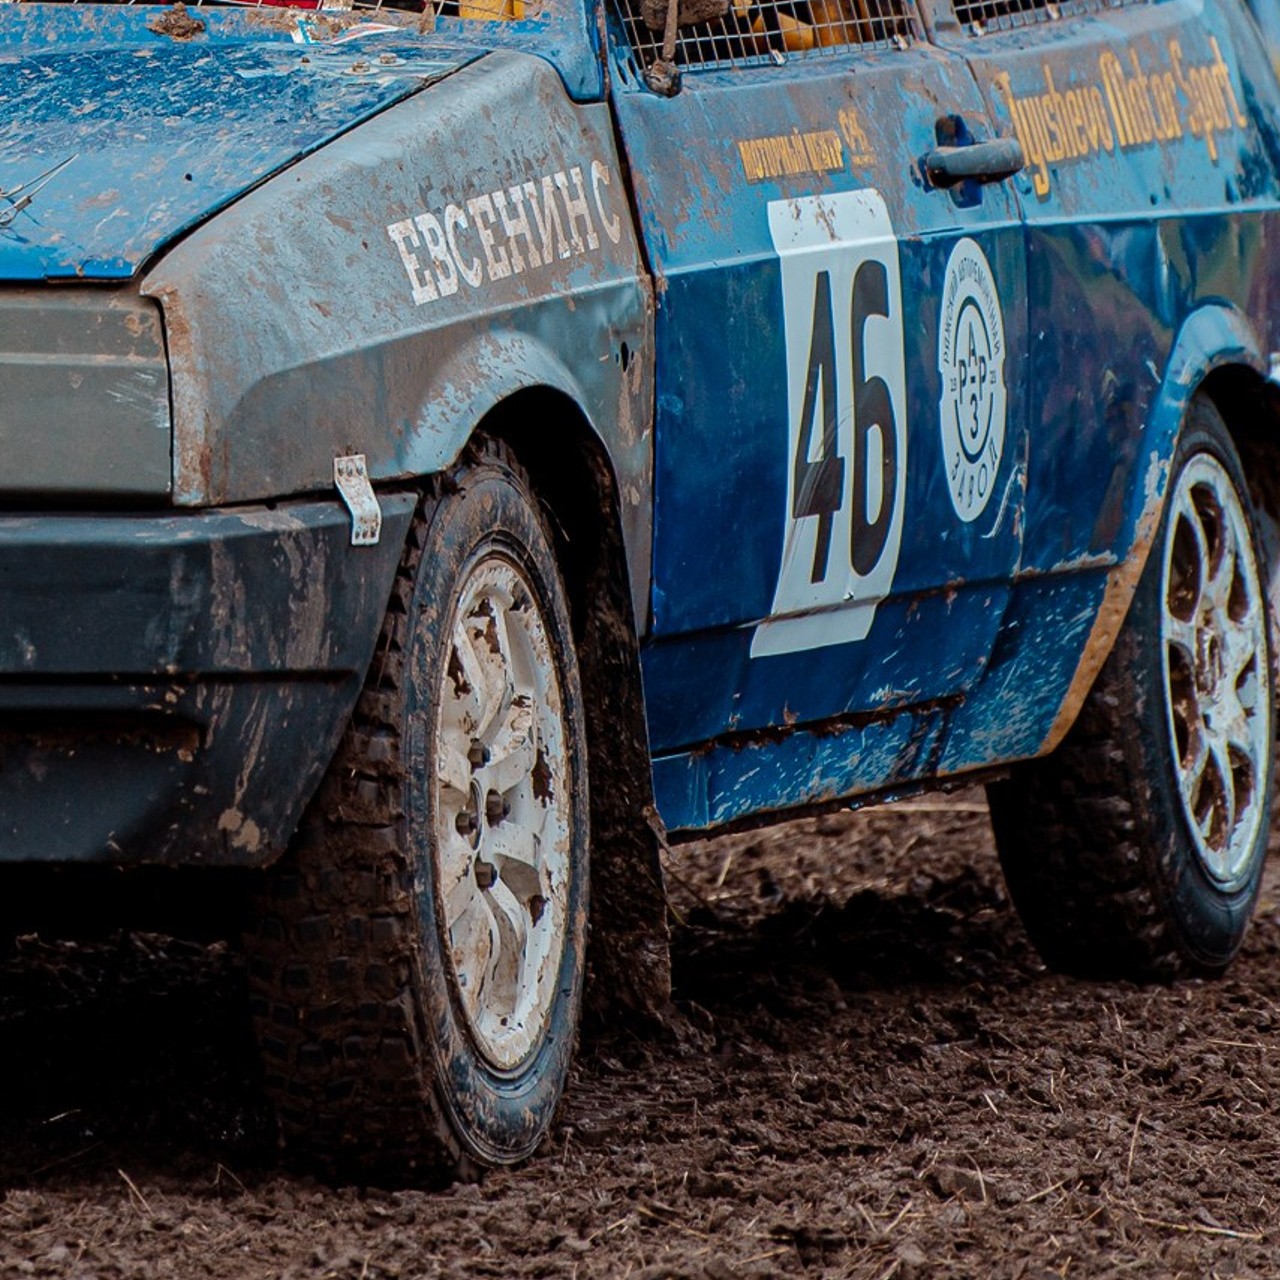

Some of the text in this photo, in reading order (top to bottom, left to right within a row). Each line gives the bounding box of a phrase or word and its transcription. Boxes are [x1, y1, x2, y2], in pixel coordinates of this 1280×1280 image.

[1099, 48, 1183, 147] Motor
[1169, 36, 1248, 160] Sport
[386, 166, 600, 306] ЕВСЕНИН
[791, 258, 898, 584] 46
